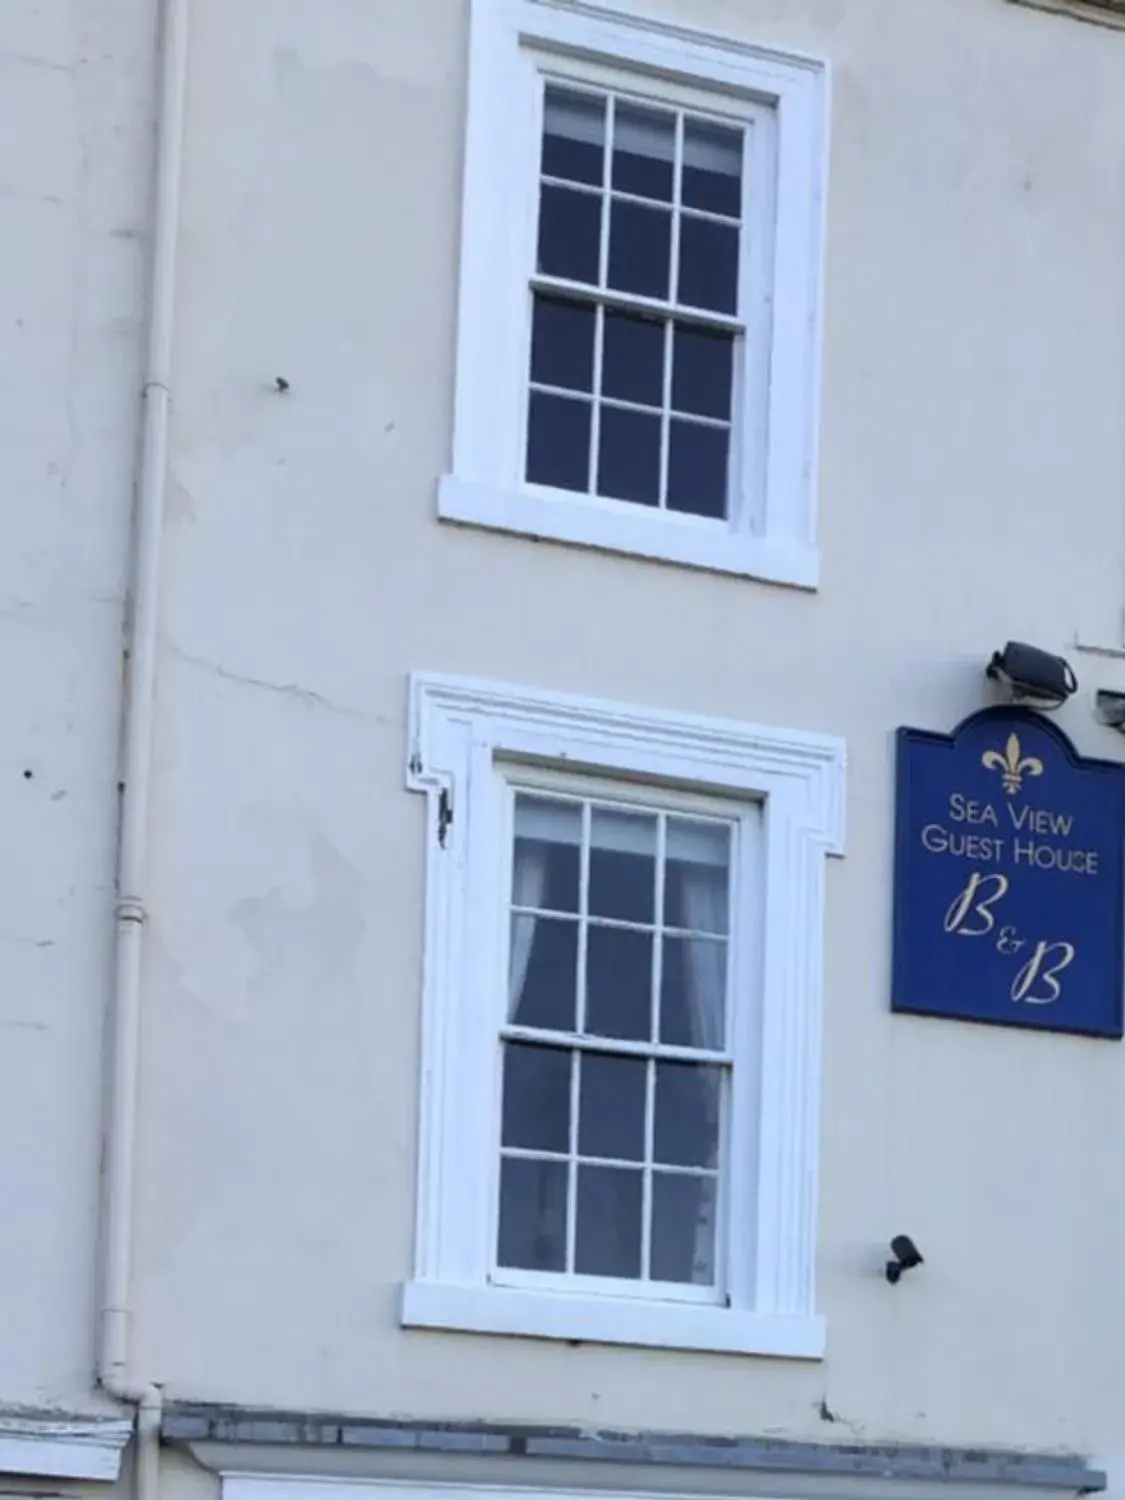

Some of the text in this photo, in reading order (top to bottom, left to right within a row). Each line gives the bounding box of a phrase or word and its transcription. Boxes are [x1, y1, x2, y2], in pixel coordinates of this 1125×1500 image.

[949, 793, 1074, 837] SEA VIEW
[921, 823, 1099, 874] GUEST HOUSE
[943, 871, 1009, 936] B
[1010, 940, 1076, 1004] B
